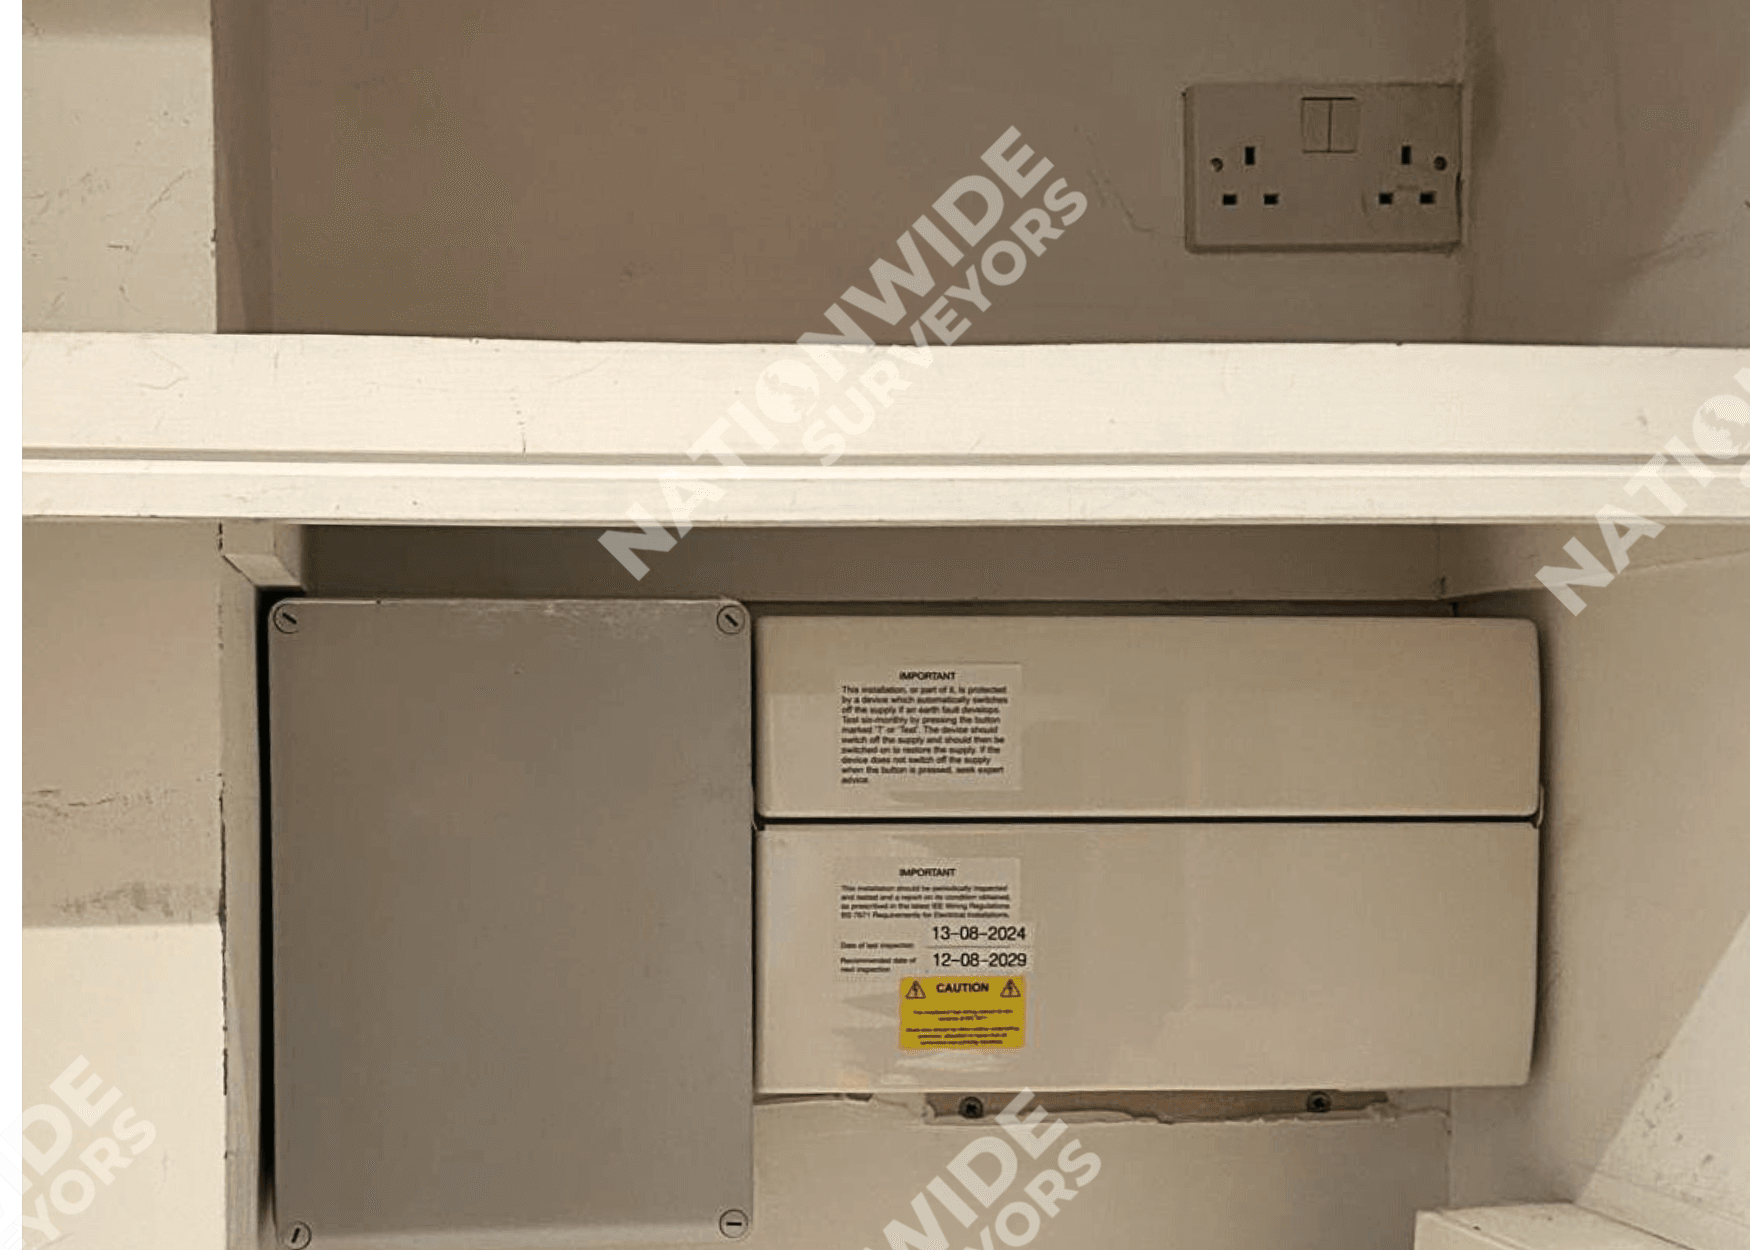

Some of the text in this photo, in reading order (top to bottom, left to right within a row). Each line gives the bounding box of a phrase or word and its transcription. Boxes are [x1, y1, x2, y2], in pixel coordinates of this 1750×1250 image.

[899, 671, 955, 680] IMPORTANT
[899, 868, 956, 877] IMPORTANT
[933, 926, 1026, 940] 13-08-2024
[933, 952, 1027, 967] 12-08-2029
[936, 982, 990, 993] CAUTION
